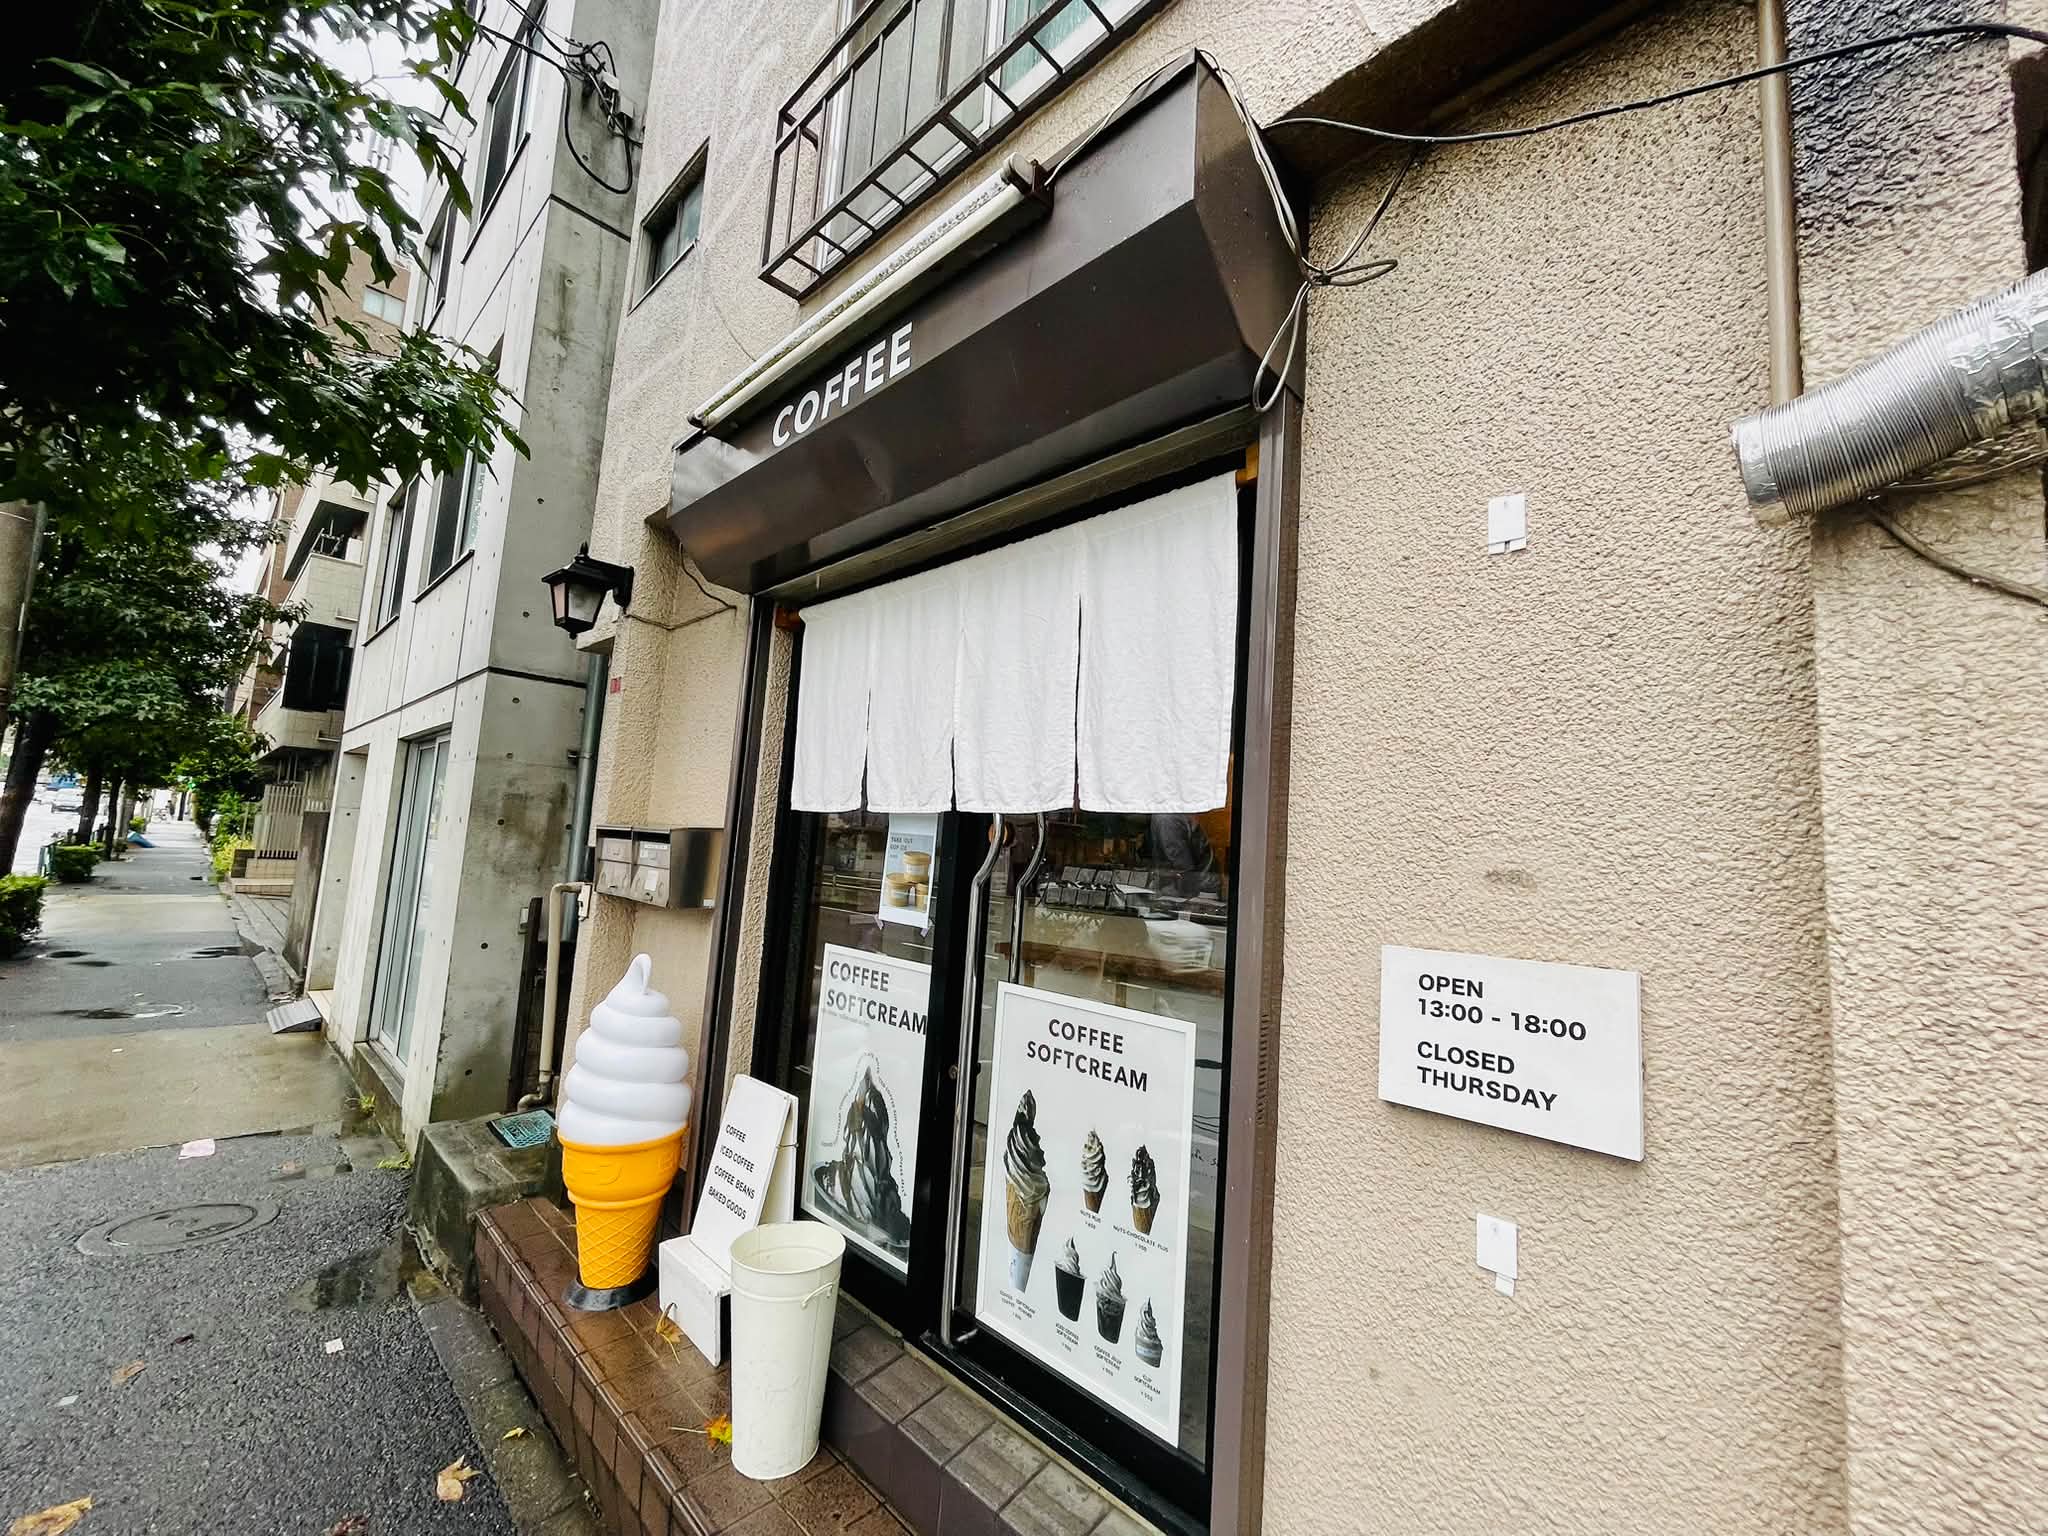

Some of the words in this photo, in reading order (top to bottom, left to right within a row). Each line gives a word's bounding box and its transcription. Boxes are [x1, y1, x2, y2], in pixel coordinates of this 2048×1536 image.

[772, 321, 913, 447] COFFEE
[830, 960, 890, 992] COFFEE
[1418, 973, 1484, 998] OPEN
[826, 988, 928, 1036] SOFTCREAM
[1418, 998, 1483, 1024] 13:00
[1510, 1012, 1587, 1041] 18:00
[1048, 1018, 1124, 1054] COFFEE
[1026, 1040, 1148, 1092] SOFTCREAM
[1417, 1040, 1515, 1075] CLOSED
[1416, 1065, 1558, 1112] THURSDAY
[725, 1124, 747, 1143] COFFEE
[719, 1144, 733, 1159] ICED
[732, 1153, 755, 1173] COFFEE
[714, 1165, 735, 1186] COFFEE
[735, 1179, 756, 1200] BEANS
[707, 1185, 727, 1205] BAKED
[725, 1199, 747, 1220] GOODS
